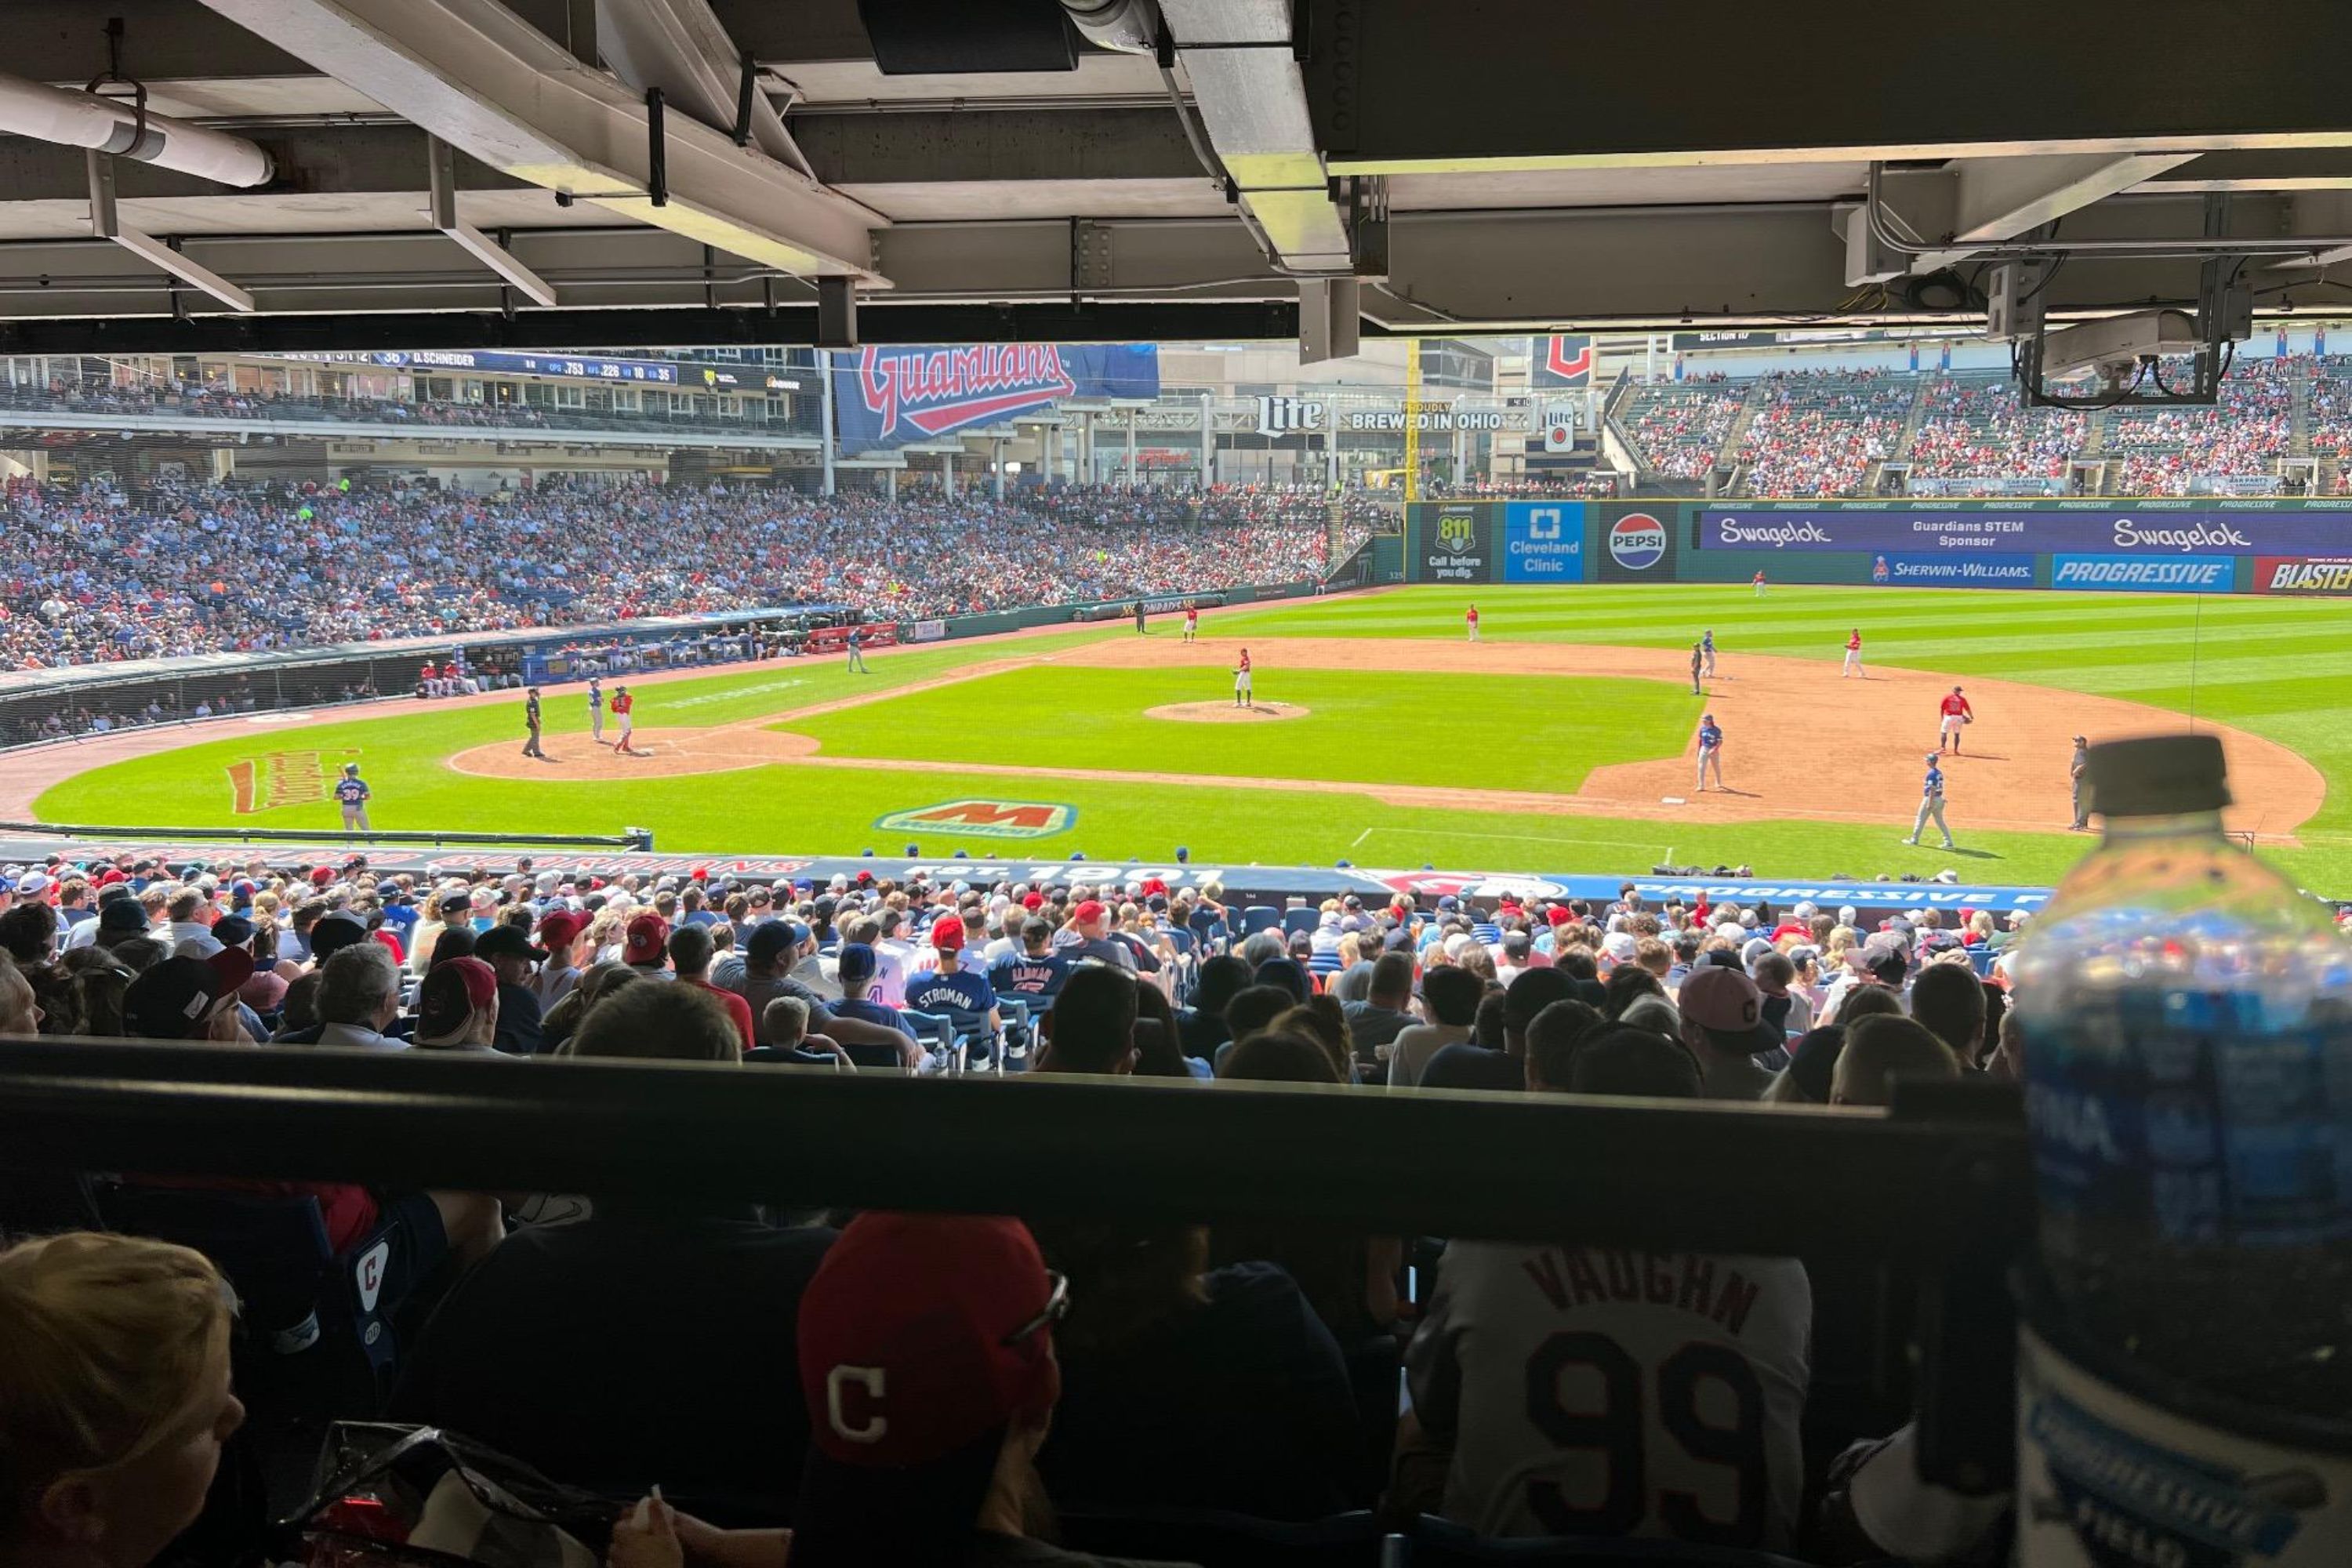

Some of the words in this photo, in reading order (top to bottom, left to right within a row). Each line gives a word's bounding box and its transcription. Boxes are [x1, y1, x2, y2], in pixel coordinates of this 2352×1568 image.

[423, 353, 475, 366] SCHNEIDER
[565, 361, 583, 375] .753
[601, 365, 619, 377] .226
[634, 366, 644, 378] 10
[860, 344, 1076, 441] Guardians
[1255, 396, 1323, 438] Lite
[1434, 413, 1454, 430] IN
[1457, 413, 1502, 430] OHIO
[1548, 412, 1571, 426] Lite
[1440, 517, 1470, 540] 811
[1721, 517, 1831, 547] Swagelok
[1913, 521, 1981, 532] Guardians
[1984, 522, 2024, 532] STEM
[2114, 519, 2251, 551] Swagelok
[1510, 541, 1579, 554] Cleveland
[1613, 535, 1662, 547] PEPSI
[1939, 535, 1997, 547] Sponsor
[1429, 556, 1447, 566] Call
[1450, 556, 1481, 566] before
[1524, 558, 1563, 572] Clinic
[1436, 569, 1454, 579] you
[2056, 562, 2222, 584] PROGRESSIVE
[2270, 564, 2352, 590] BLASTE
[343, 788, 359, 800] 39
[910, 803, 1057, 828] M
[903, 866, 1011, 876] EST.
[1028, 866, 1225, 884] 1901
[1635, 884, 1997, 903] PROGRESSIVE
[918, 988, 973, 1010] STROMAN
[365, 1256, 376, 1290] C
[1523, 1248, 1761, 1334] VAUGHN
[827, 1364, 887, 1443] C
[1525, 1330, 1765, 1550] 99
